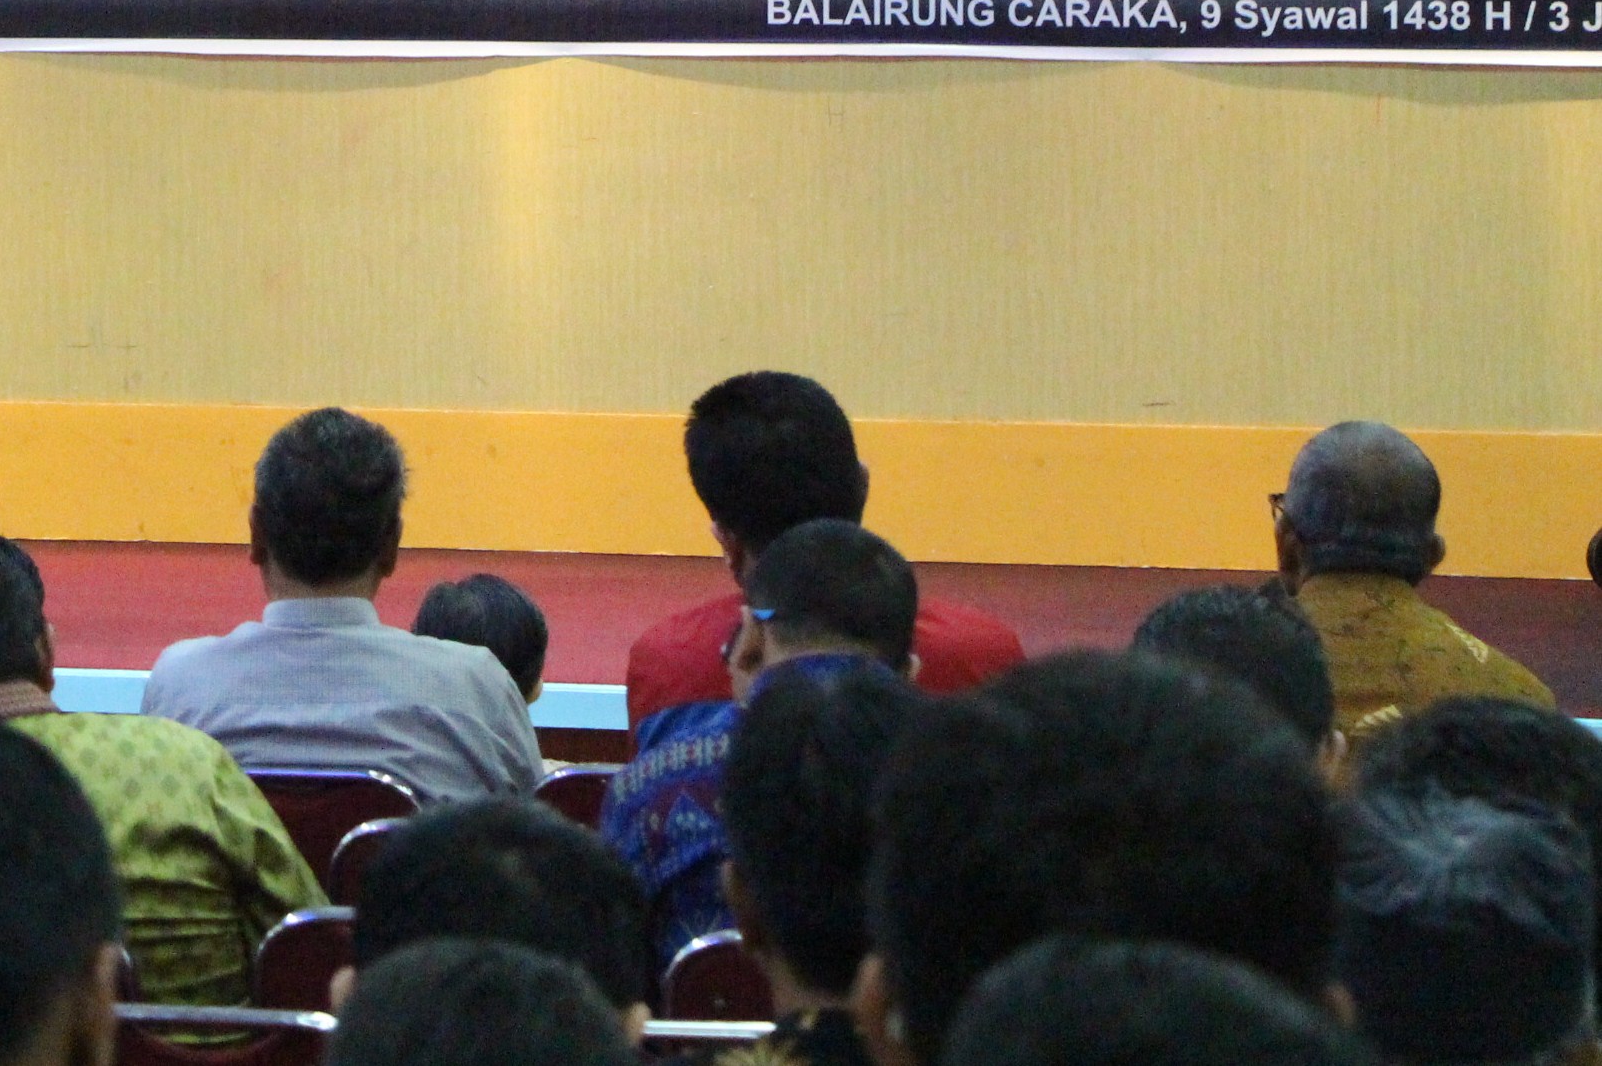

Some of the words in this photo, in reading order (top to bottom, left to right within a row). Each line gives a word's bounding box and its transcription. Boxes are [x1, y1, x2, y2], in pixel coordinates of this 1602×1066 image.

[1383, 0, 1471, 31] 1438
[1485, 0, 1511, 31] H
[1523, 0, 1537, 31] /
[1549, 1, 1570, 32] 3
